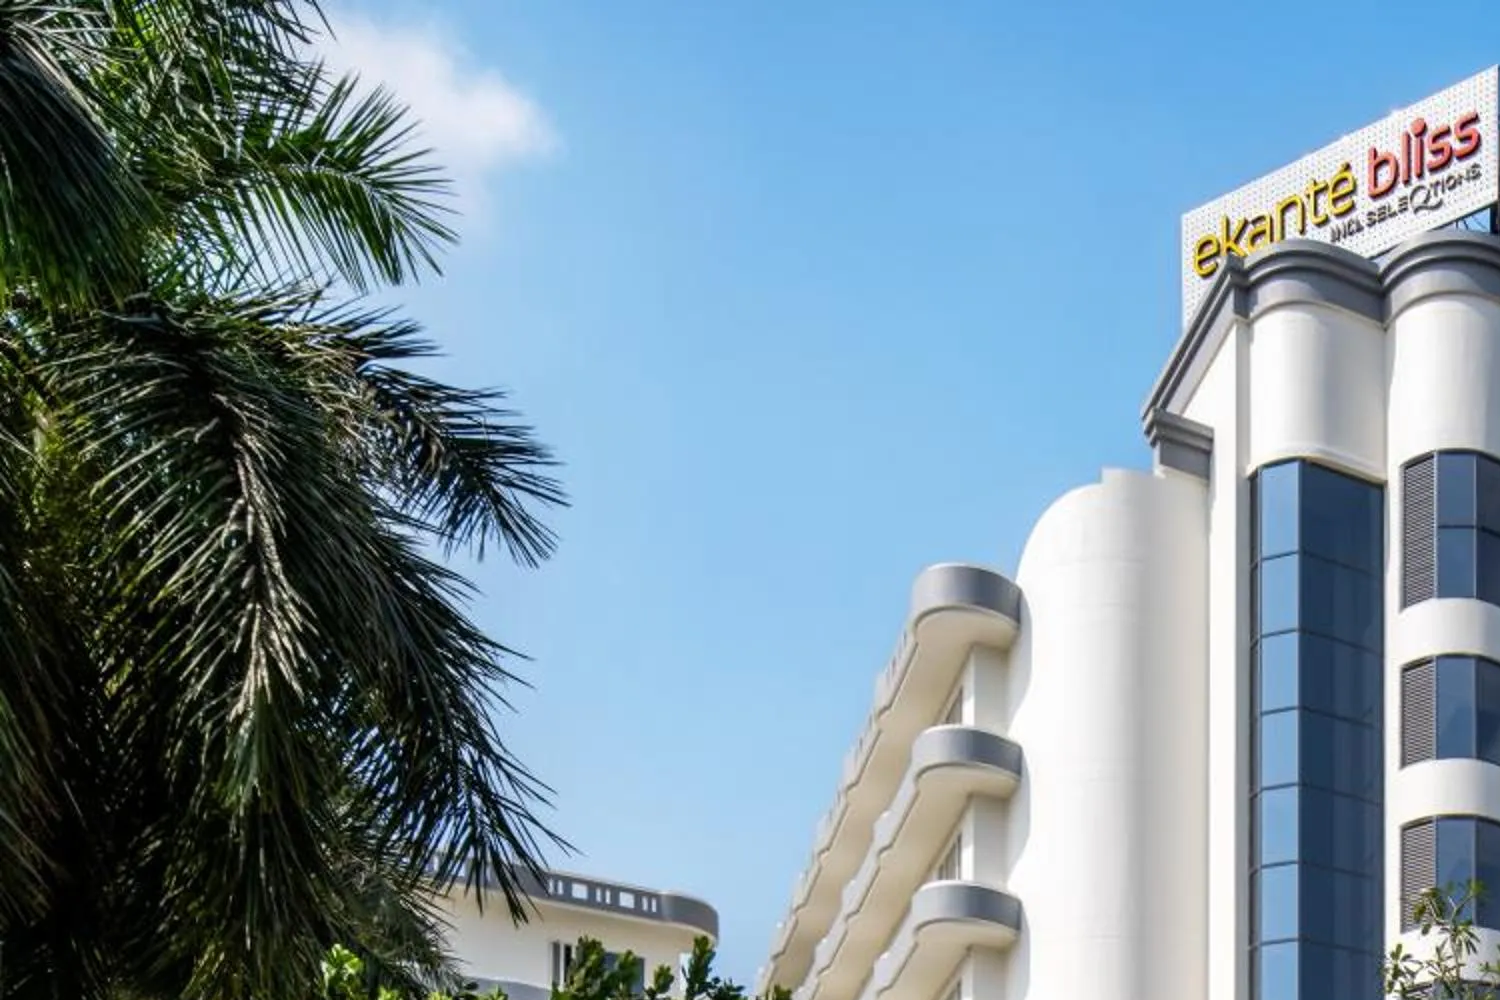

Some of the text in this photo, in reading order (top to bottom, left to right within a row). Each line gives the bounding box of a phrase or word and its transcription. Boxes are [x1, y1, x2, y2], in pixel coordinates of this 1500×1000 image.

[1193, 108, 1482, 279] ekanté bliss
[1366, 162, 1482, 228] SELEQTIONS
